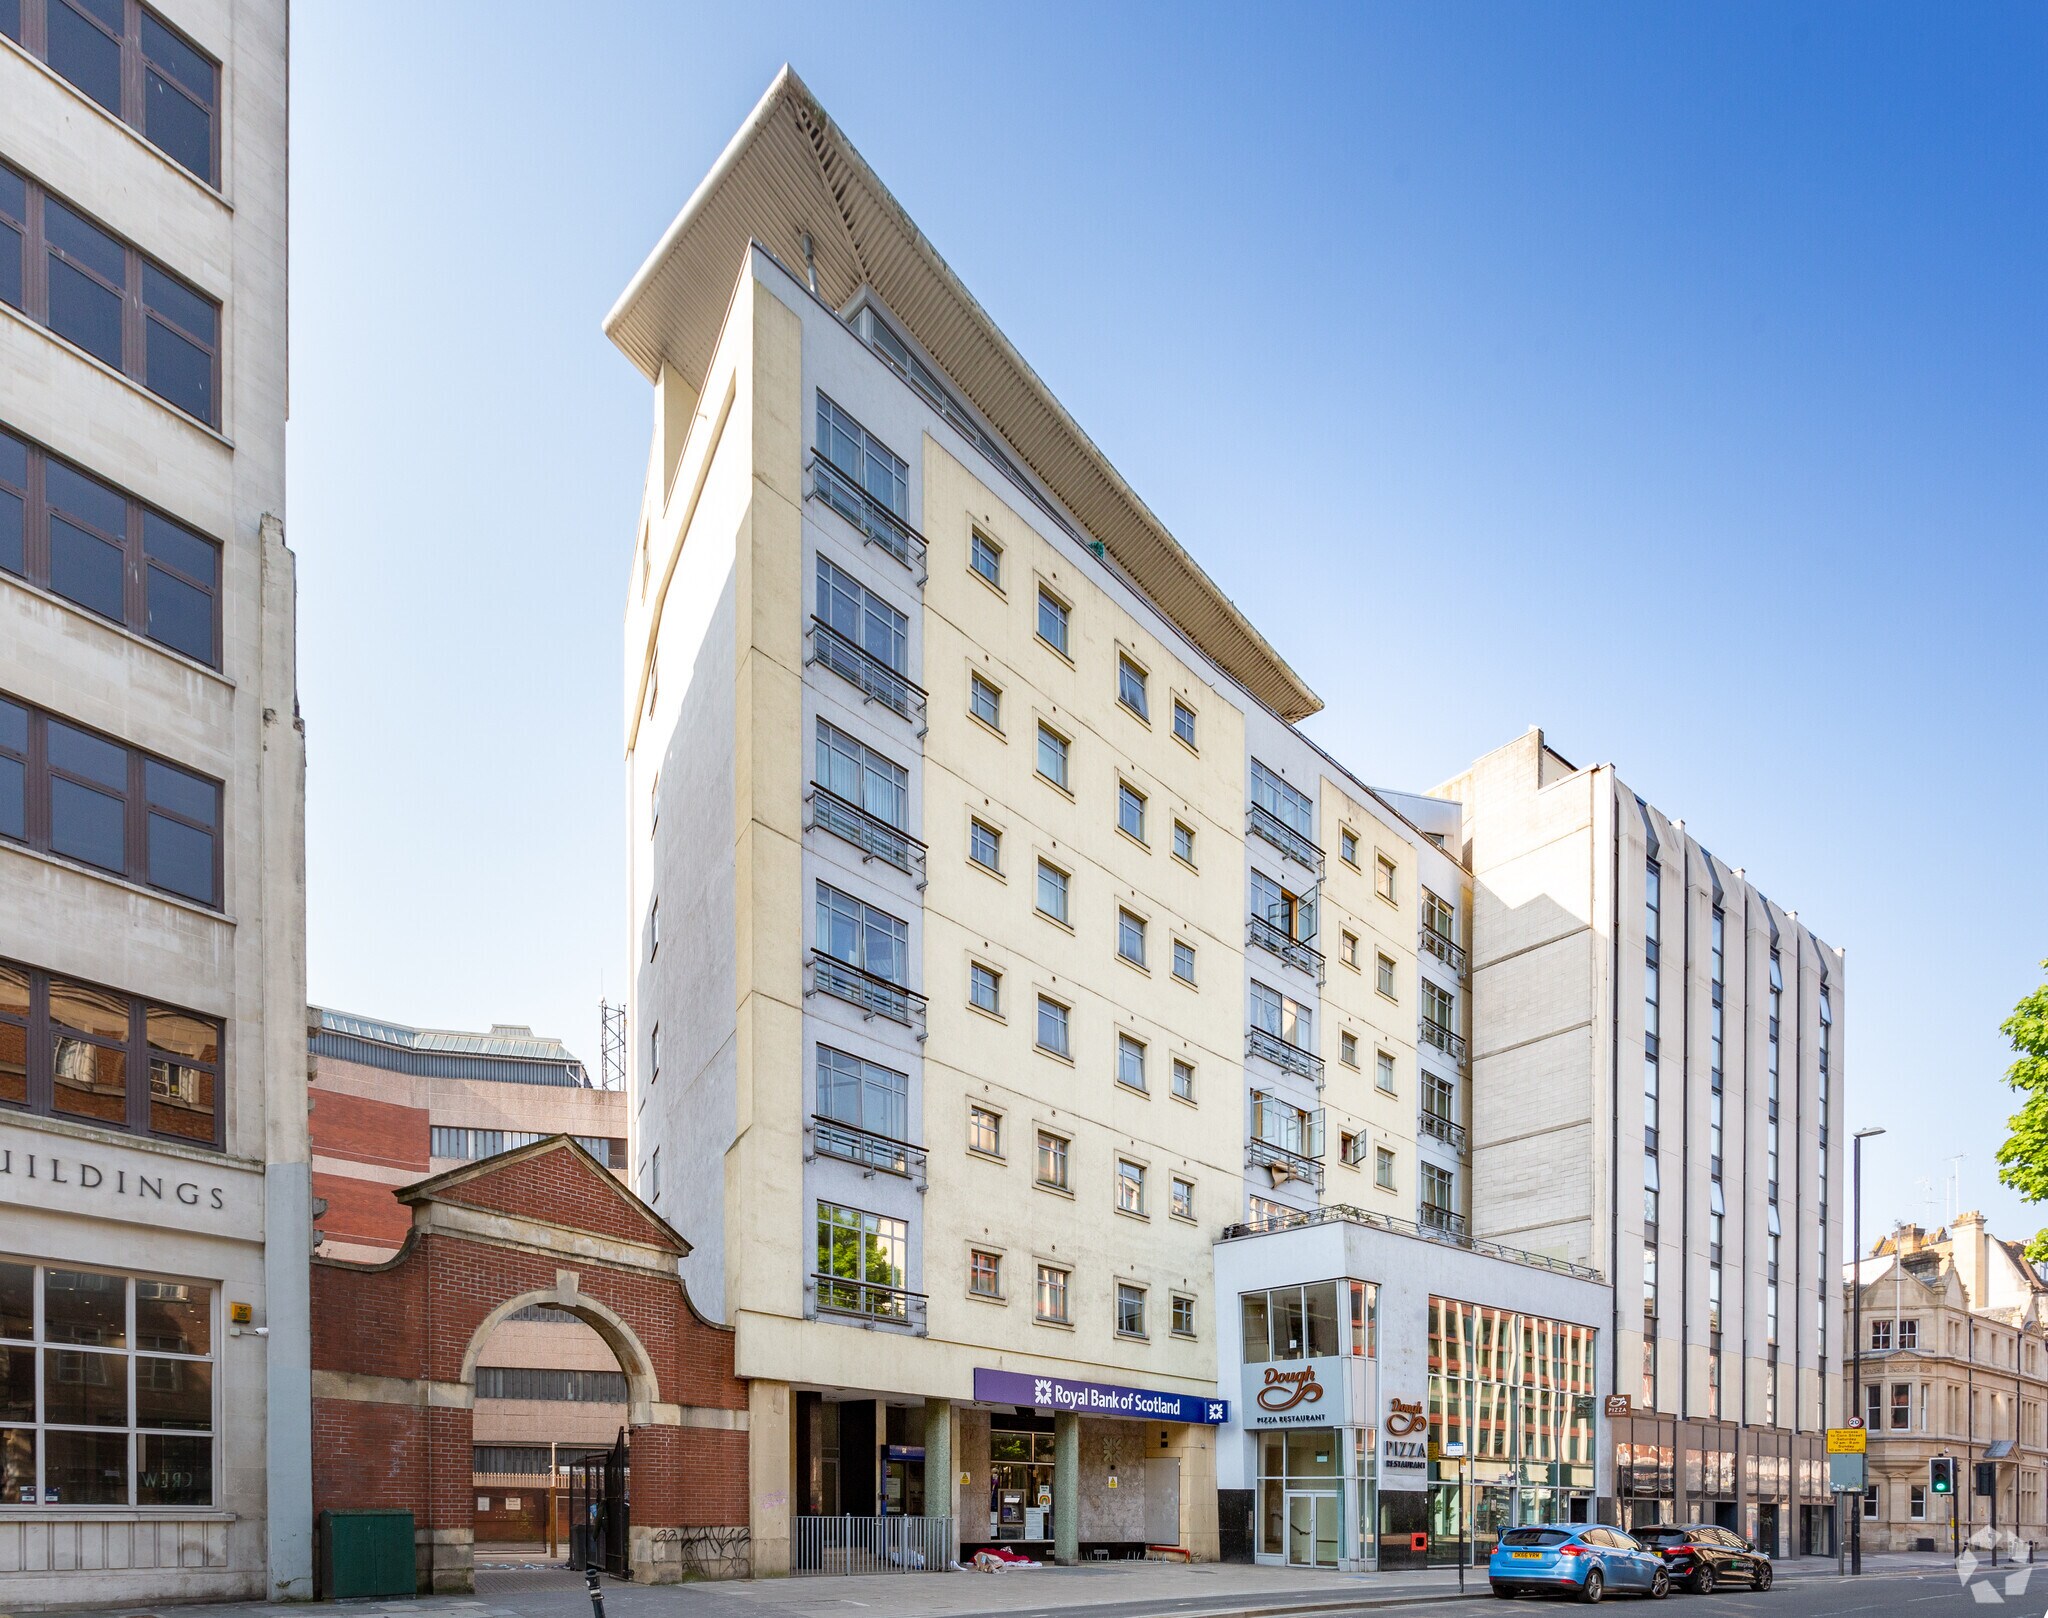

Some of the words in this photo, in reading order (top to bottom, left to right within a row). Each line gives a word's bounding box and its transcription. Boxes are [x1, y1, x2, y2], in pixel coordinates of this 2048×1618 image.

[1055, 1385, 1088, 1409] Royal
[1091, 1389, 1119, 1409] Bank
[1121, 1393, 1134, 1409] of
[1135, 1395, 1180, 1415] Scotland
[1279, 1414, 1326, 1423] RESTAURANT
[1386, 1441, 1426, 1458] PIZZA
[1386, 1461, 1426, 1469] RESTAURANT
